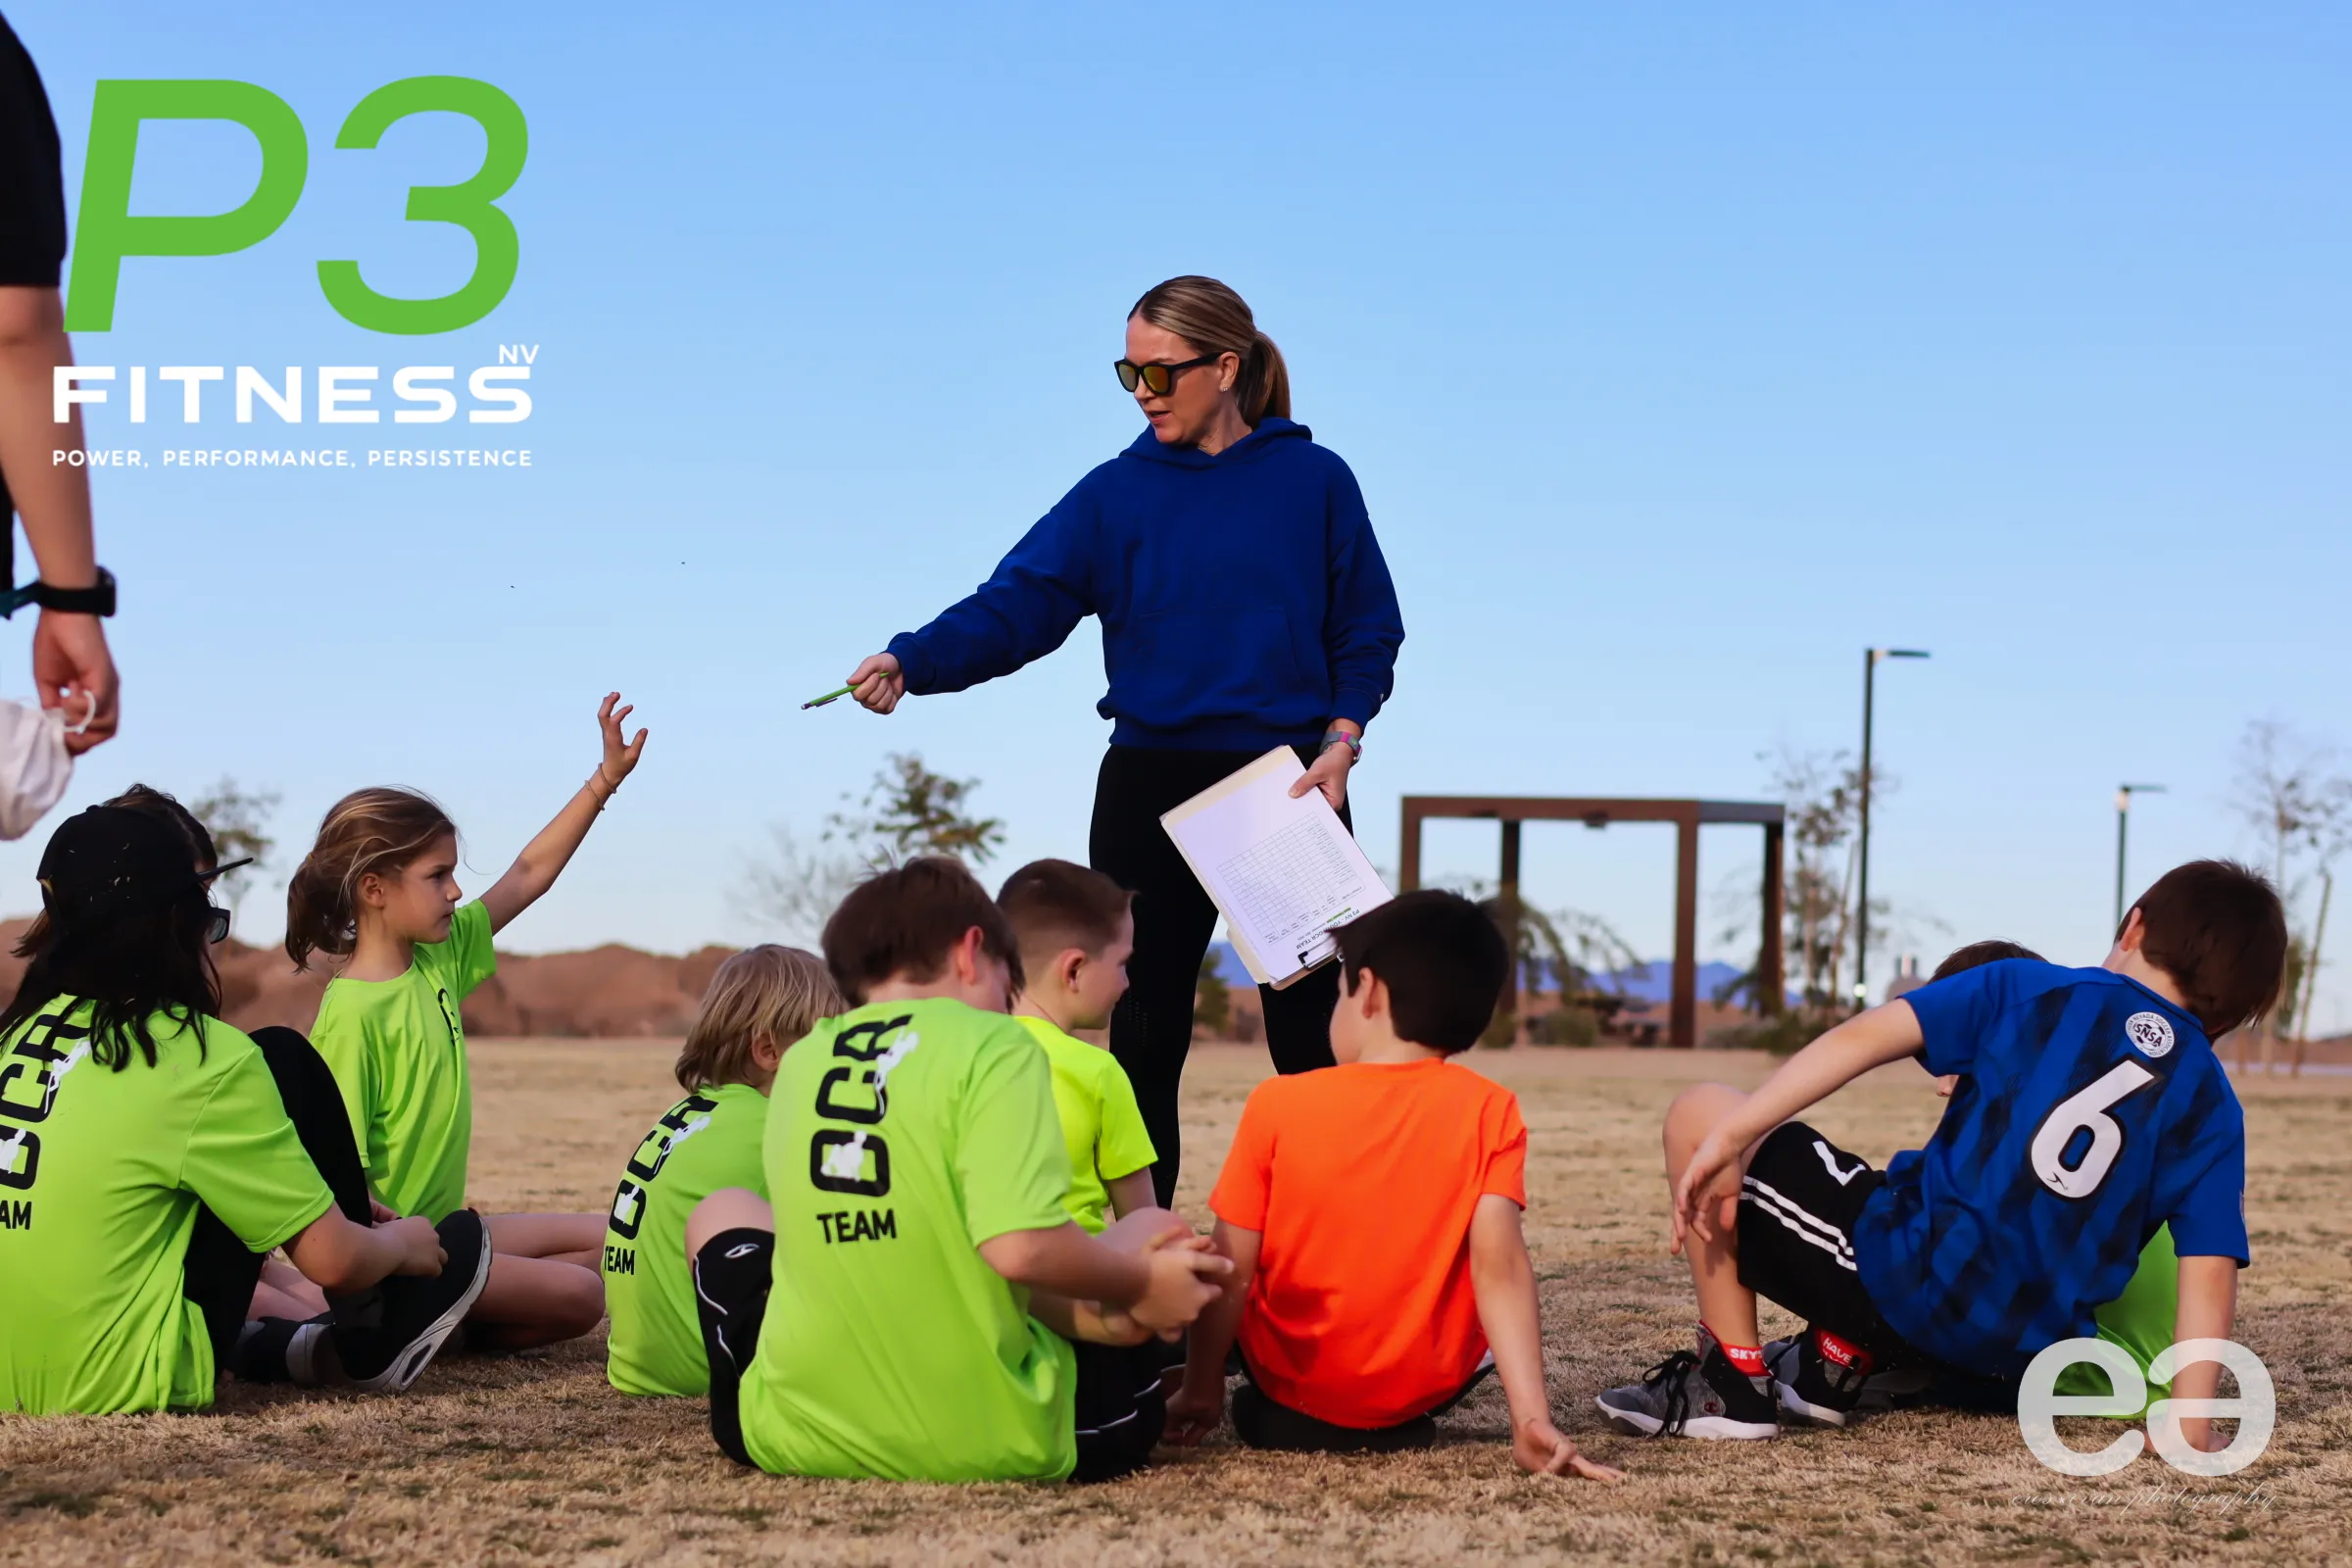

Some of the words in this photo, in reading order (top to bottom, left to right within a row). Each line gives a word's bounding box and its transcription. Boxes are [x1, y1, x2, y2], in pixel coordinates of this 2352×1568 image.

[1295, 937, 1311, 950] TEAM
[2133, 1023, 2163, 1048] SNSA
[2030, 1058, 2156, 1200] 6
[0, 1200, 32, 1230] AM
[816, 1208, 898, 1245] TEAM
[604, 1245, 636, 1276] TEAM
[1820, 1337, 1852, 1363] HAVE
